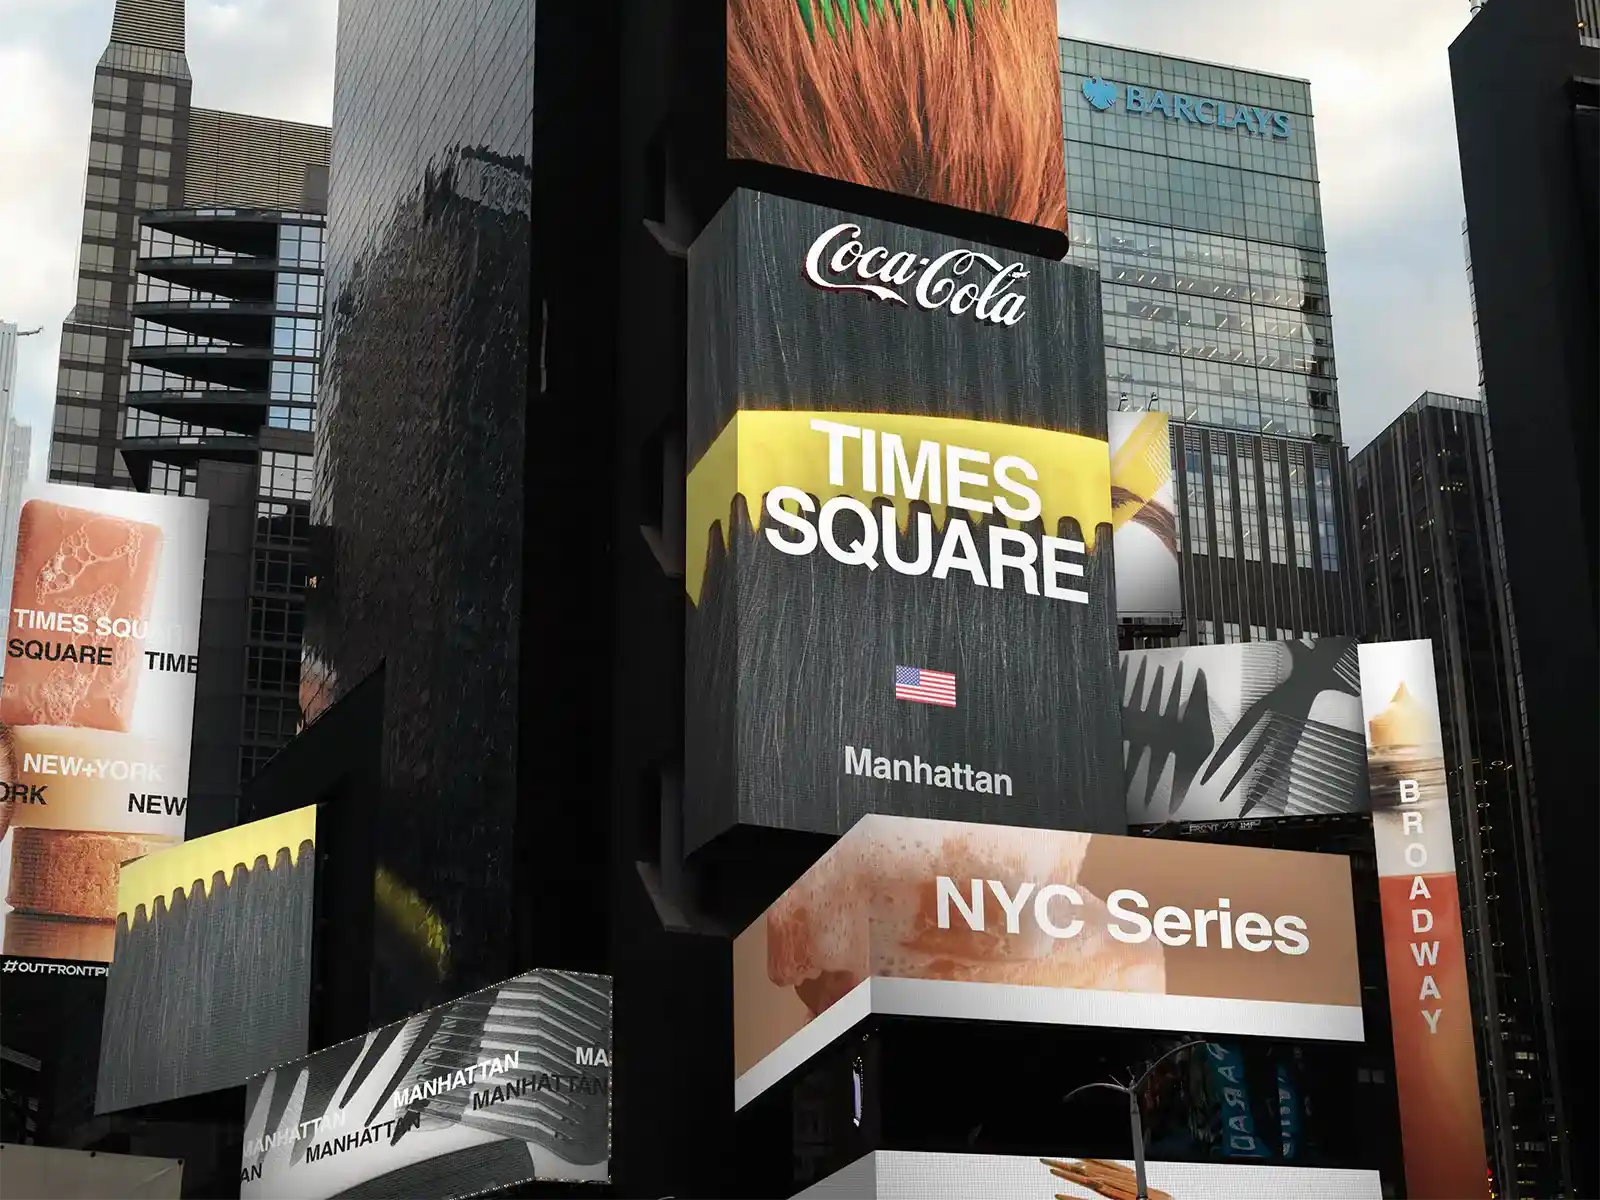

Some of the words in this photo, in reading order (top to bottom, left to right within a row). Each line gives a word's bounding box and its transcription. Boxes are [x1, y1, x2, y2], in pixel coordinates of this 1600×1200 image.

[1126, 85, 1292, 139] BARCLAYS
[805, 223, 1030, 326] Coca-Cola
[810, 419, 1041, 522] TIMES
[765, 486, 1089, 604] SQUARE
[14, 608, 89, 634] TIMES
[8, 639, 112, 666] SQUARE
[844, 745, 1012, 797] Manhattan
[128, 793, 188, 817] NEW
[936, 875, 1085, 940] NYC
[1106, 889, 1309, 956] Series
[1399, 779, 1442, 1035] BROADWAY
[393, 1051, 519, 1109] MANHATTAN
[472, 1073, 610, 1111] MANHATTAN
